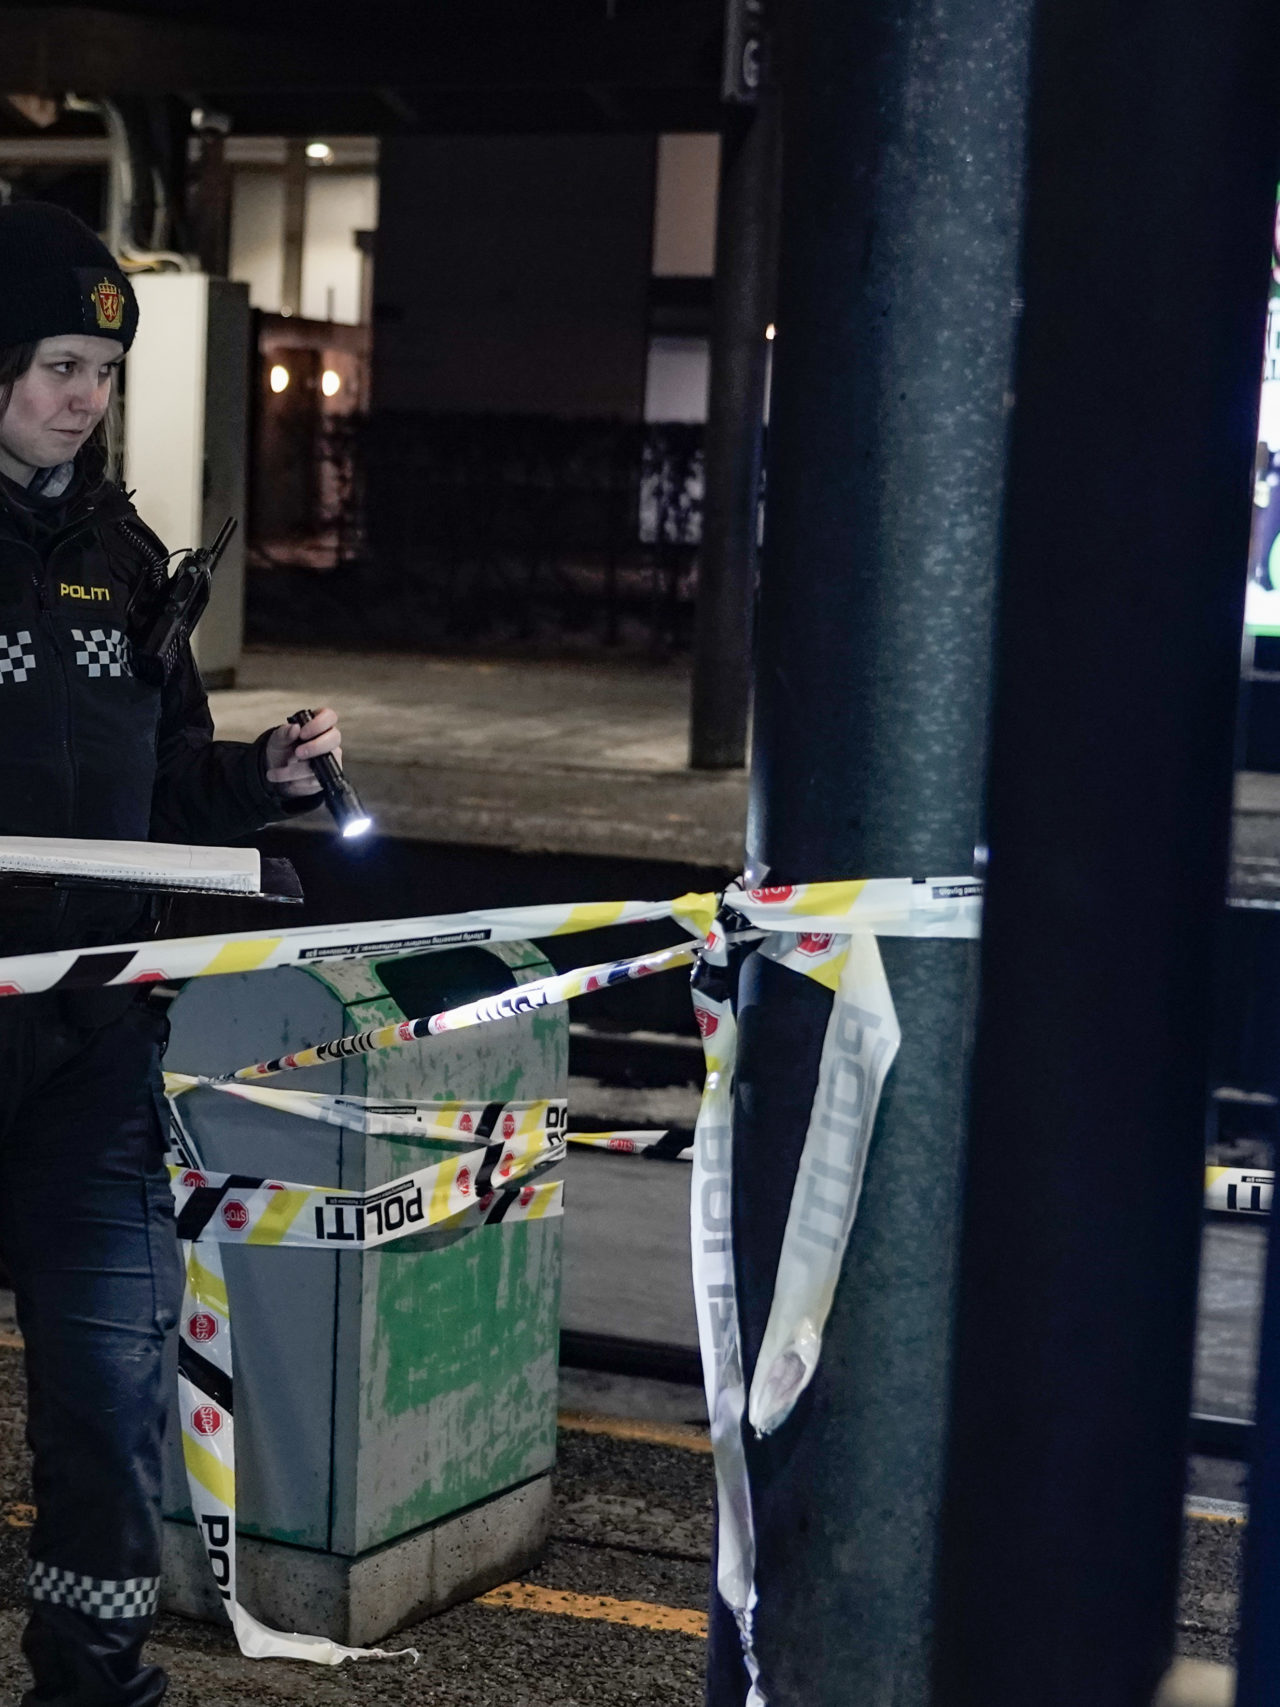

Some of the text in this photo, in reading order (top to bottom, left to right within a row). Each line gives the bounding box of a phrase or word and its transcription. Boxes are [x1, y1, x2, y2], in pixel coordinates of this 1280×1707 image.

[60, 583, 110, 601] POLITI
[224, 1209, 247, 1221] STOP
[315, 1187, 425, 1241] POLITI
[196, 1314, 209, 1339] STOP
[201, 1407, 215, 1435] STOP
